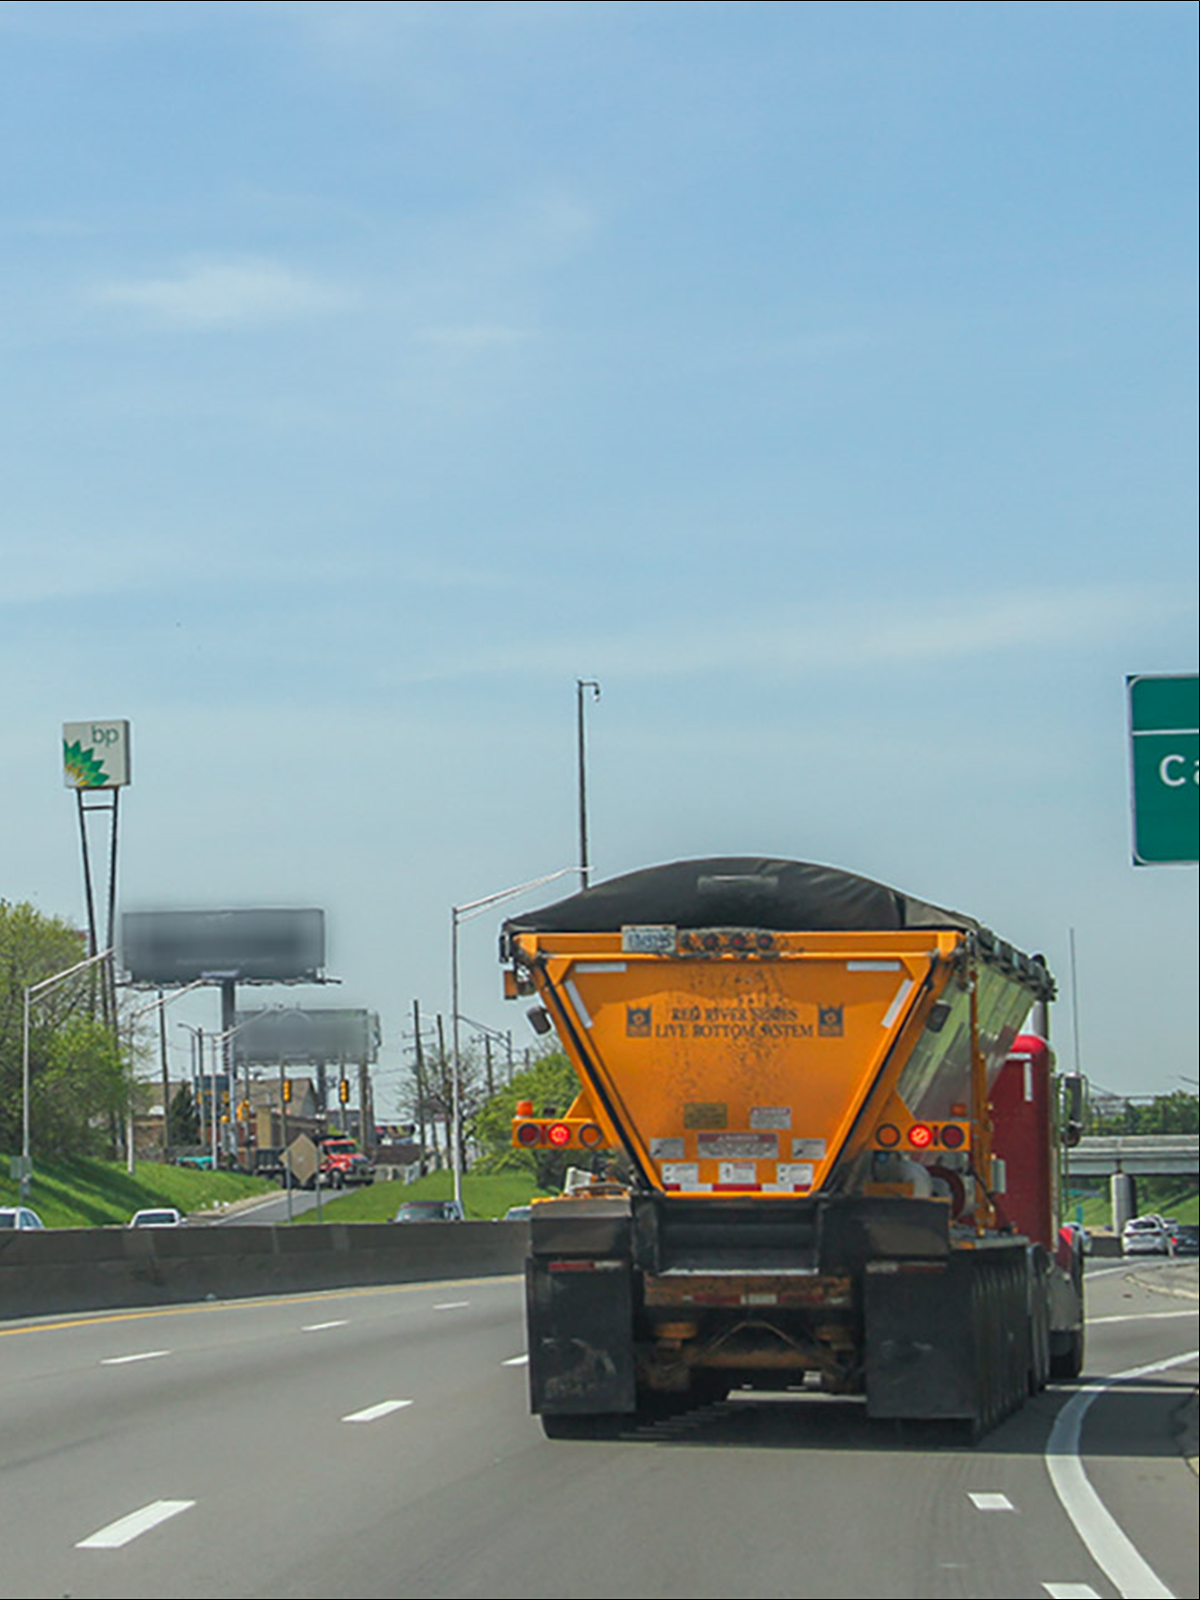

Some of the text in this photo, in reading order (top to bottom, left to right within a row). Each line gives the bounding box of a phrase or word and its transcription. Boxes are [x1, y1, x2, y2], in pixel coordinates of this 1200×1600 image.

[91, 725, 120, 748] bp
[671, 1005, 702, 1021] RED
[705, 1006, 747, 1021] RIVER
[656, 1023, 688, 1037] LIVE
[692, 1023, 757, 1038] BOTTOM
[760, 1023, 813, 1038] SYSTEM
